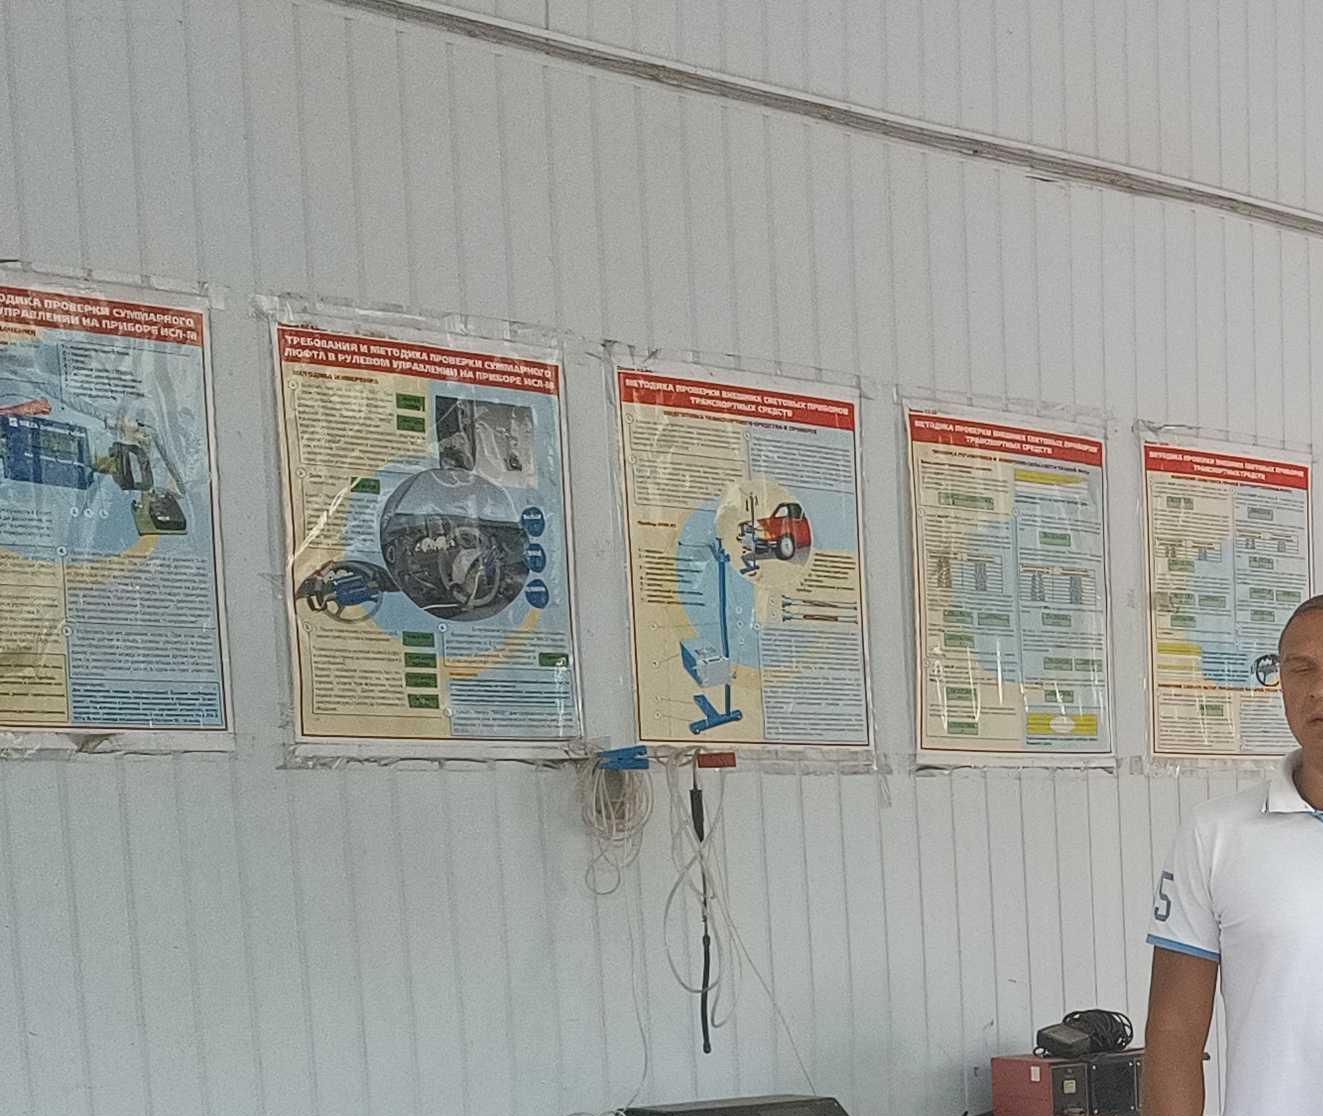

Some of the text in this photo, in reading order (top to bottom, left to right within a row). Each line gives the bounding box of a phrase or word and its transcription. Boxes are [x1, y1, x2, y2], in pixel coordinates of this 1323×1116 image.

[44, 299, 110, 316] ПРОВЕРКИ
[112, 308, 195, 327] СУММАРНОГО
[82, 317, 100, 328] НА
[102, 319, 158, 335] ПРИБОРЕ
[284, 347, 326, 360] ЛЮФТА
[338, 354, 390, 367] РУЛЕВОМ
[392, 359, 458, 377] УПРАВЛЕНИИ
[460, 368, 474, 379] НА
[476, 371, 522, 385] ПРИБОРЕ
[285, 335, 552, 378] ТРЕБОВАНИЯ И МЕТОДИКА ПРОВЕРКИ СУММАРНОГО
[1154, 870, 1174, 921] 5
